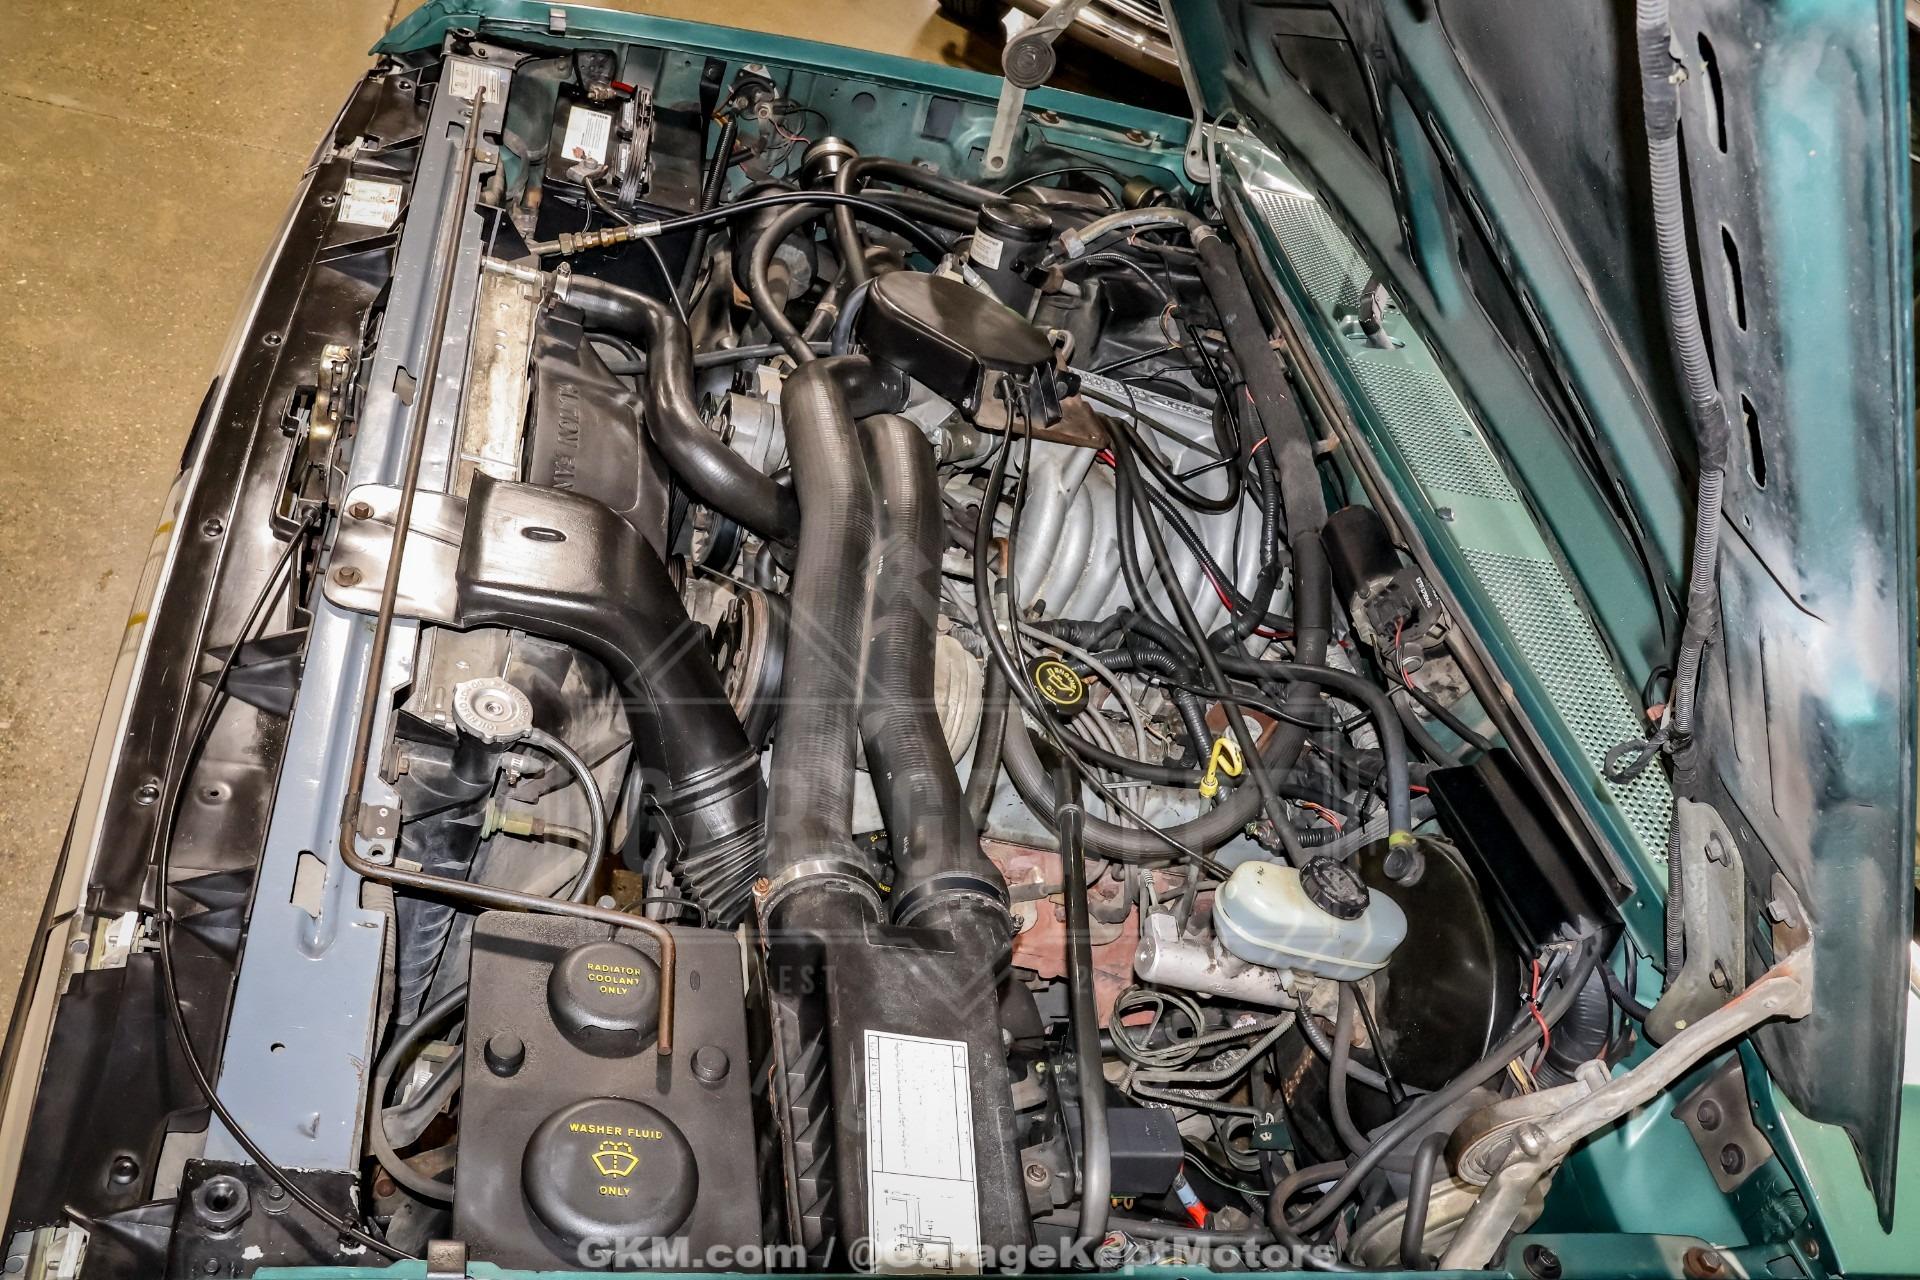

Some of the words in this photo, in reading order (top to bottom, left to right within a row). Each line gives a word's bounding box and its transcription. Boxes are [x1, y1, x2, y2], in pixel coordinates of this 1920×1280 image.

[1054, 667, 1077, 690] ENGINE
[1046, 685, 1057, 697] OIL
[587, 962, 641, 976] RADIATOR
[588, 973, 640, 985] COOLANT
[599, 985, 628, 996] ONLY
[569, 1123, 622, 1136] WASHER
[627, 1128, 663, 1140] FLUID
[600, 1186, 631, 1197] ONLY
